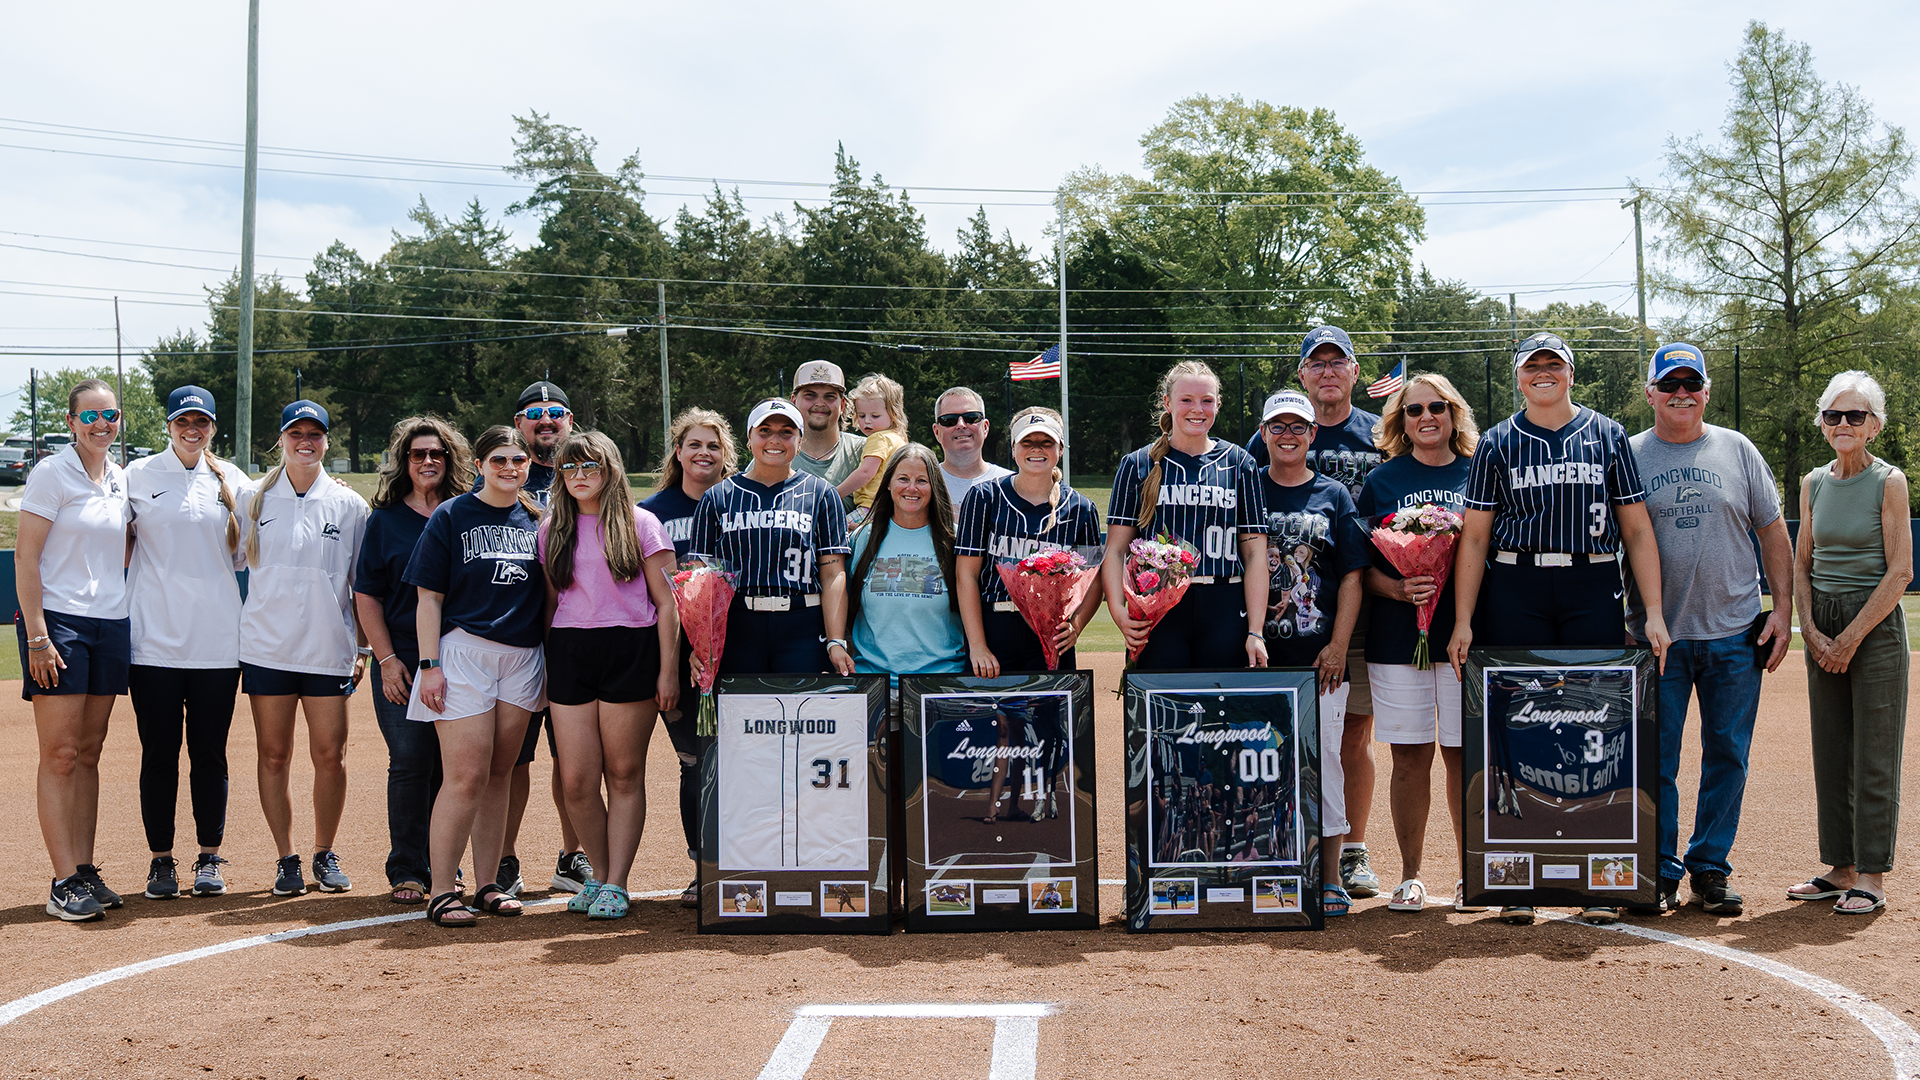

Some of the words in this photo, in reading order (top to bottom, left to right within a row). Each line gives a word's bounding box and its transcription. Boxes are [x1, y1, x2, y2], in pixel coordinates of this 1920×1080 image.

[180, 395, 204, 406] LANCERS
[295, 405, 318, 416] LANCERS
[1274, 397, 1305, 405] LONGWOOD
[1511, 461, 1604, 490] LANCERS
[1644, 466, 1722, 500] LONGWOOD
[1156, 484, 1236, 509] ANCERS
[1397, 489, 1464, 513] LONGWOO
[1660, 504, 1714, 518] SOFTBALL
[722, 510, 812, 534] LANCERS
[1589, 502, 1607, 537] 3
[461, 525, 538, 564] LONGWOO
[1206, 525, 1237, 561] 00
[784, 547, 812, 584] 31
[743, 719, 836, 735] LONGWOOD
[1511, 700, 1609, 730] Longwood
[1176, 721, 1271, 750] Longwood
[1584, 730, 1603, 763] 3
[947, 737, 1045, 766] Longwood
[1239, 748, 1280, 782] 00
[810, 757, 851, 791] 31
[1022, 766, 1047, 800] 11
